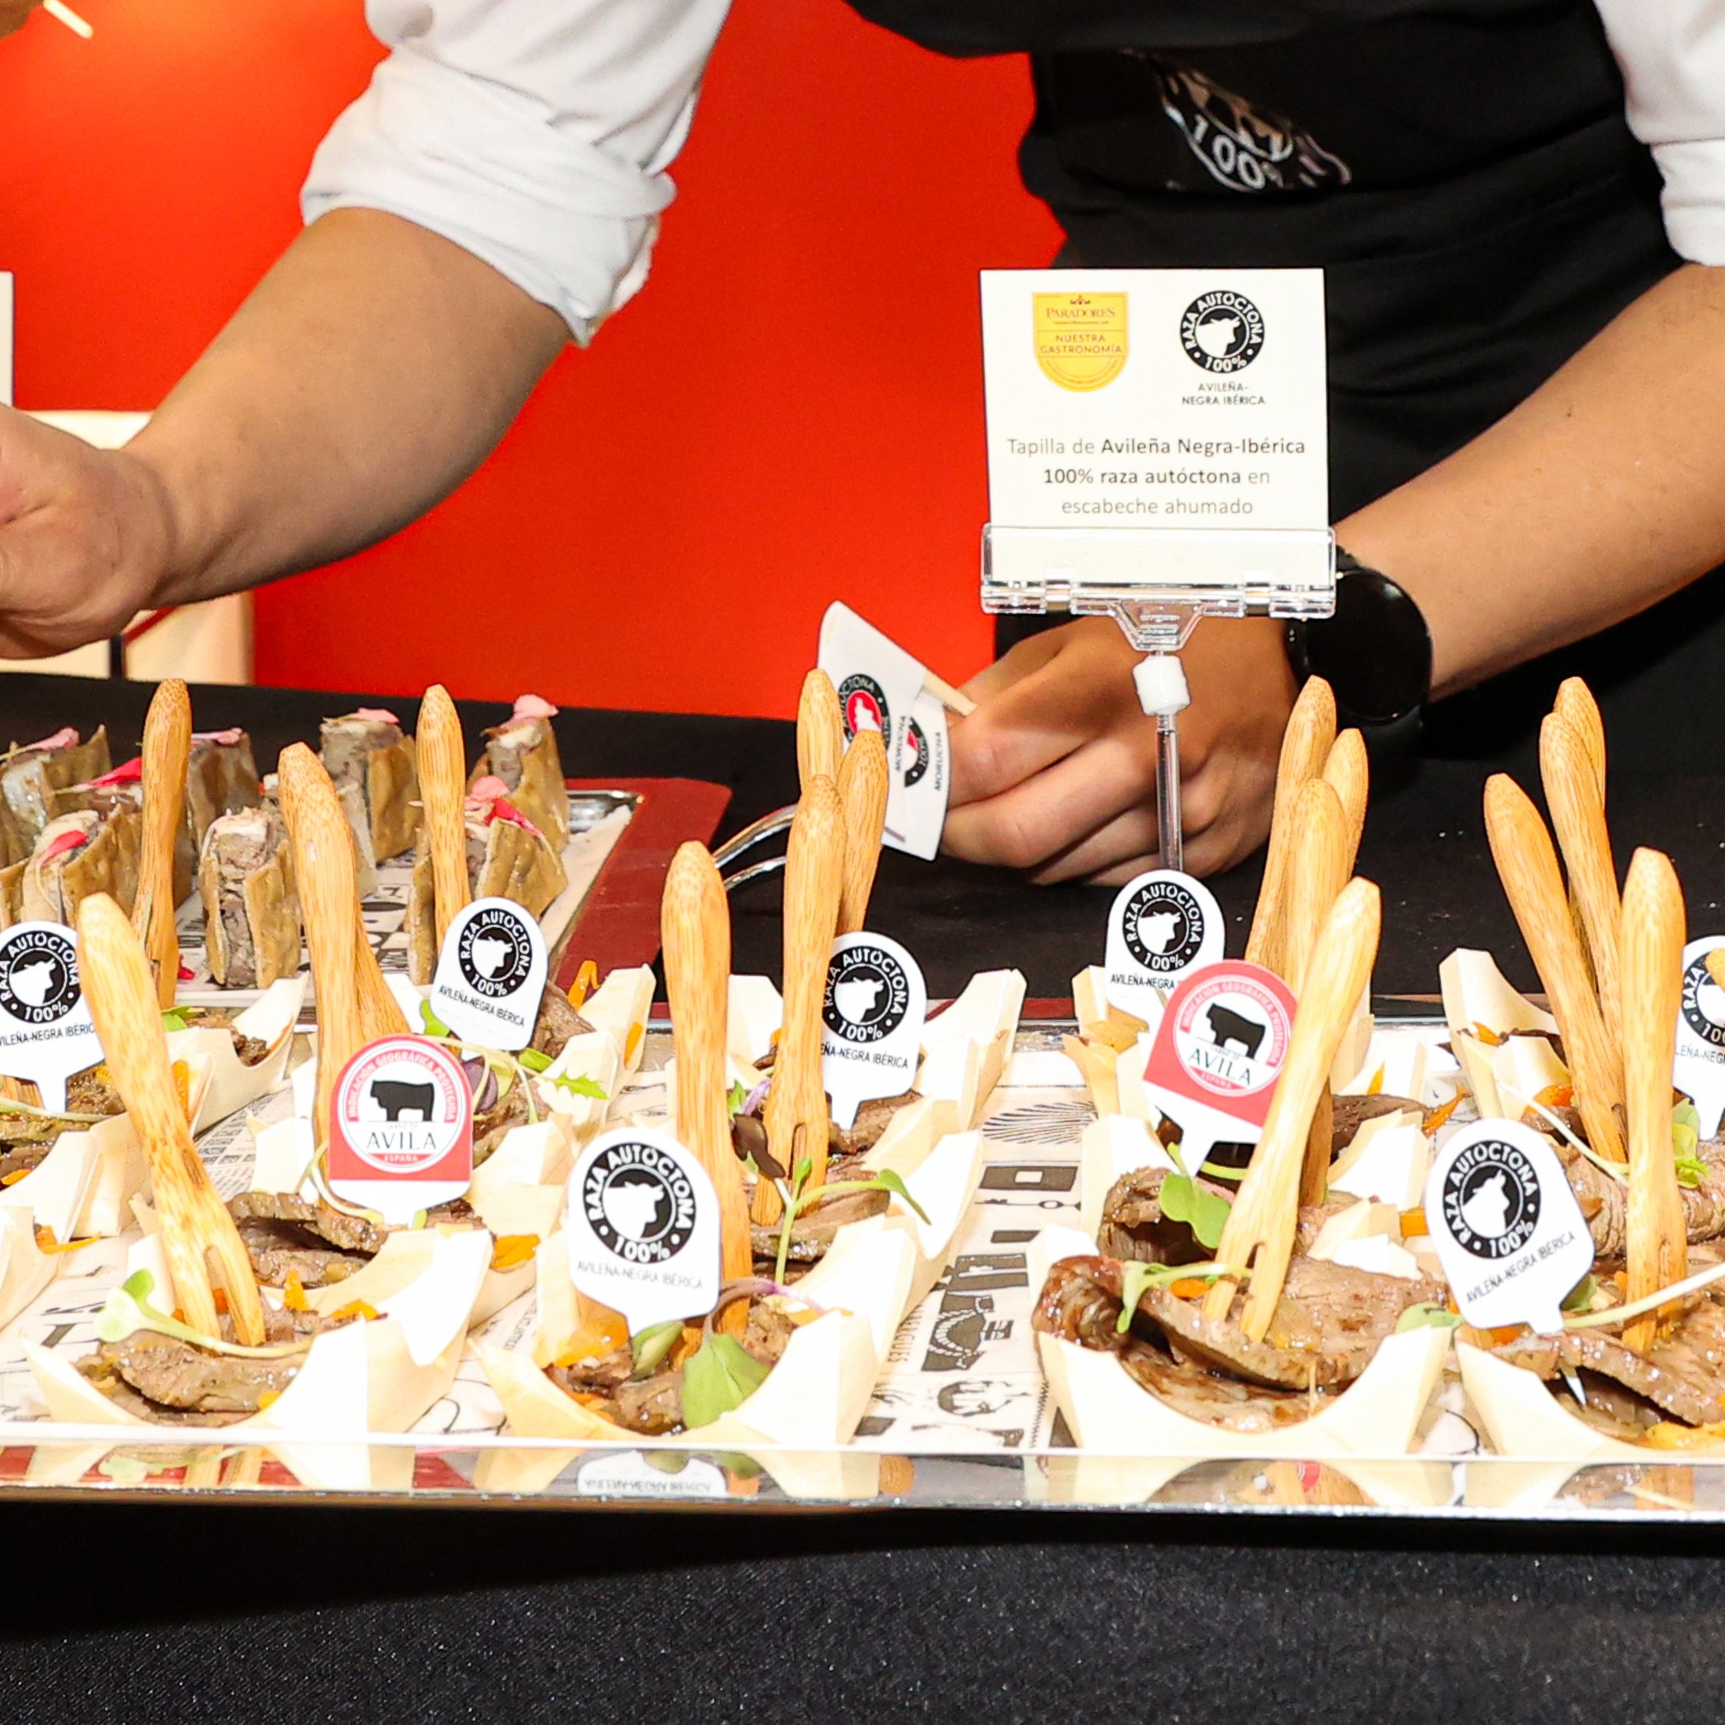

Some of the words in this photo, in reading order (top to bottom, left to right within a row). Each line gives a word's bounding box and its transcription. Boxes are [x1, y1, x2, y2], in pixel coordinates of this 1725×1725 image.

[1046, 307, 1115, 318] PARADORES
[1055, 334, 1105, 343] NUESTRA
[1182, 312, 1199, 349] RAZA
[1205, 355, 1247, 372] 100%
[1182, 396, 1219, 406] NEGRA
[1223, 393, 1265, 406] IBÉRICA
[1007, 438, 1065, 458] Tapilla
[1072, 438, 1095, 454] de
[1101, 438, 1171, 454] Avileña
[1177, 437, 1306, 458] Negra-Ibérica
[1044, 468, 1094, 484] 100%
[1100, 472, 1138, 484] raza
[1145, 468, 1241, 484] autóctona
[1248, 472, 1270, 484] en
[1061, 498, 1158, 514] escabeche
[1165, 498, 1253, 514] ahumado
[1125, 903, 1142, 942] RAZA
[461, 922, 480, 959] RAZA
[1144, 952, 1184, 970] 100%
[471, 973, 507, 996] 100%
[1110, 973, 1175, 989] AVILEÑA-NEGRA
[1683, 967, 1705, 1010] RAZA
[25, 1001, 69, 1022] 100%
[438, 984, 495, 1014] AVILEÑA-NEGRA
[496, 1008, 524, 1027] IBÉRICA
[65, 1023, 95, 1037] IBÉRIC
[838, 1021, 883, 1041] 100%
[873, 1052, 908, 1069] IBÉRICA
[585, 1166, 608, 1221] RAZA
[1445, 1191, 1472, 1244] RAZA
[614, 1234, 671, 1263] 100%
[1489, 1219, 1535, 1257] 100%
[577, 1260, 659, 1283] AVILEÑA-NEGRA
[662, 1272, 703, 1289] IBÉRICA
[1467, 1254, 1537, 1304] AVILEÑA-NEGRA
[1539, 1230, 1576, 1260] IBÉRICA
